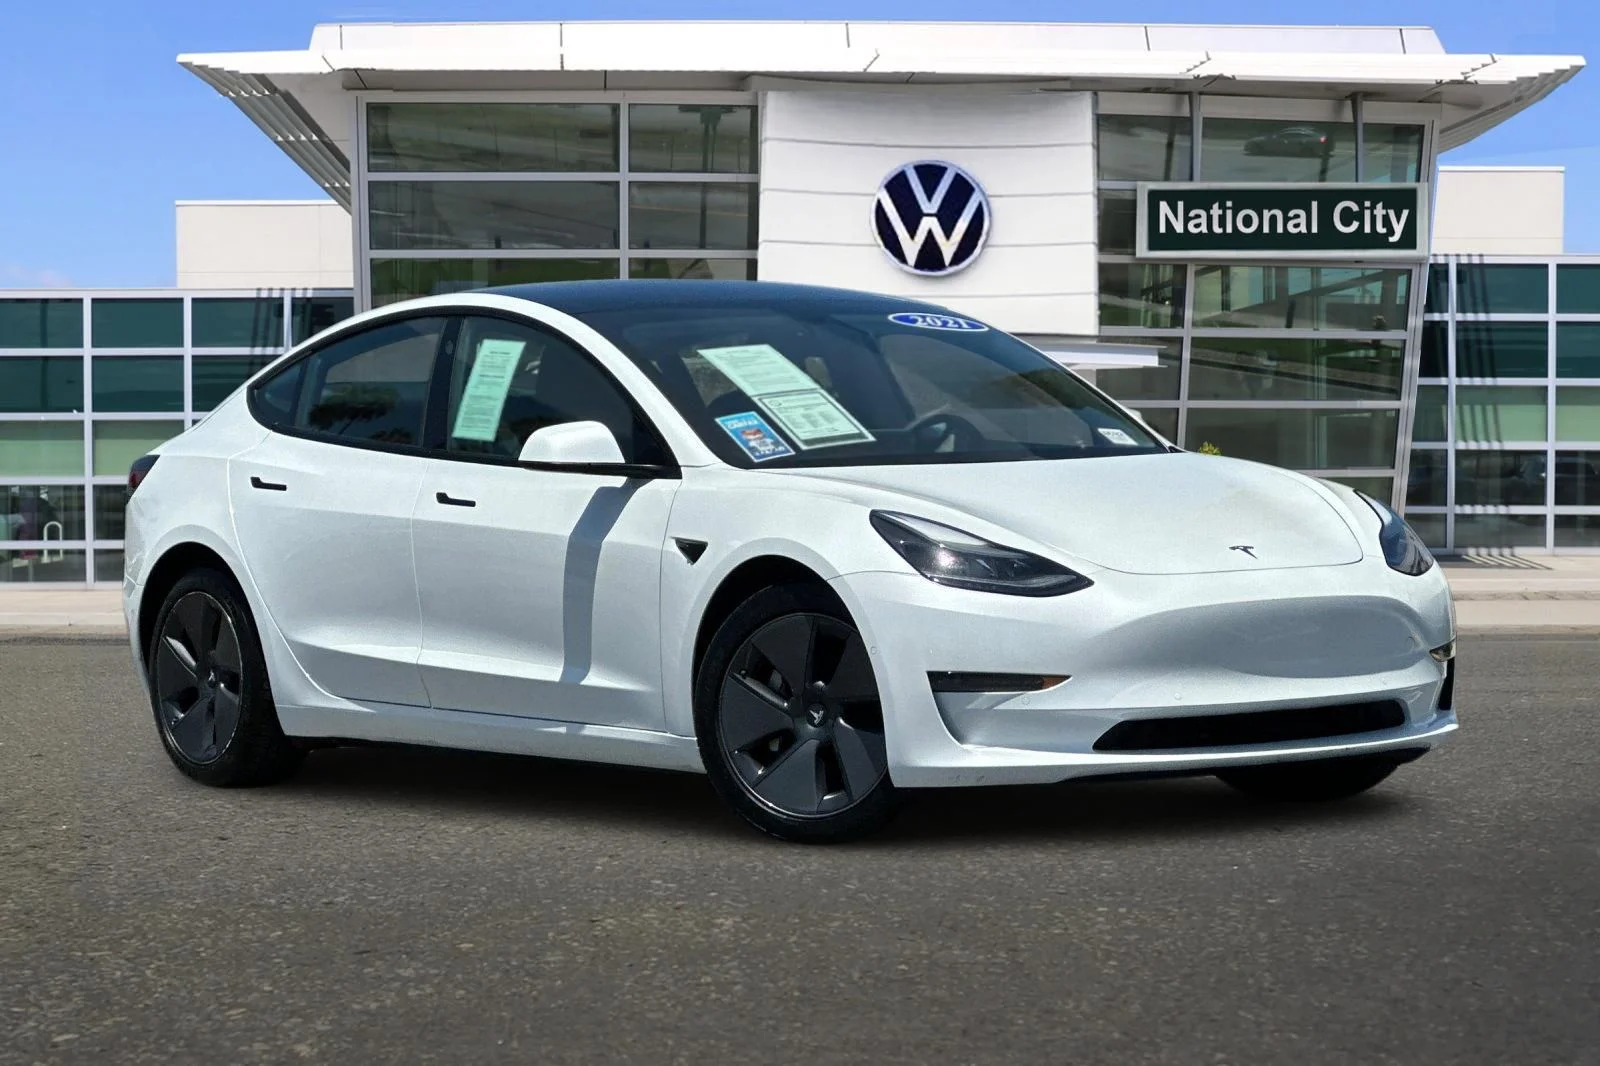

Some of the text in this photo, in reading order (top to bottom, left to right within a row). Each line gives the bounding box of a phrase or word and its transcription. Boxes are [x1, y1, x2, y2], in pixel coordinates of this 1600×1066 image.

[878, 163, 984, 269] VW
[1158, 200, 1410, 243] National City
[909, 315, 971, 328] 2021
